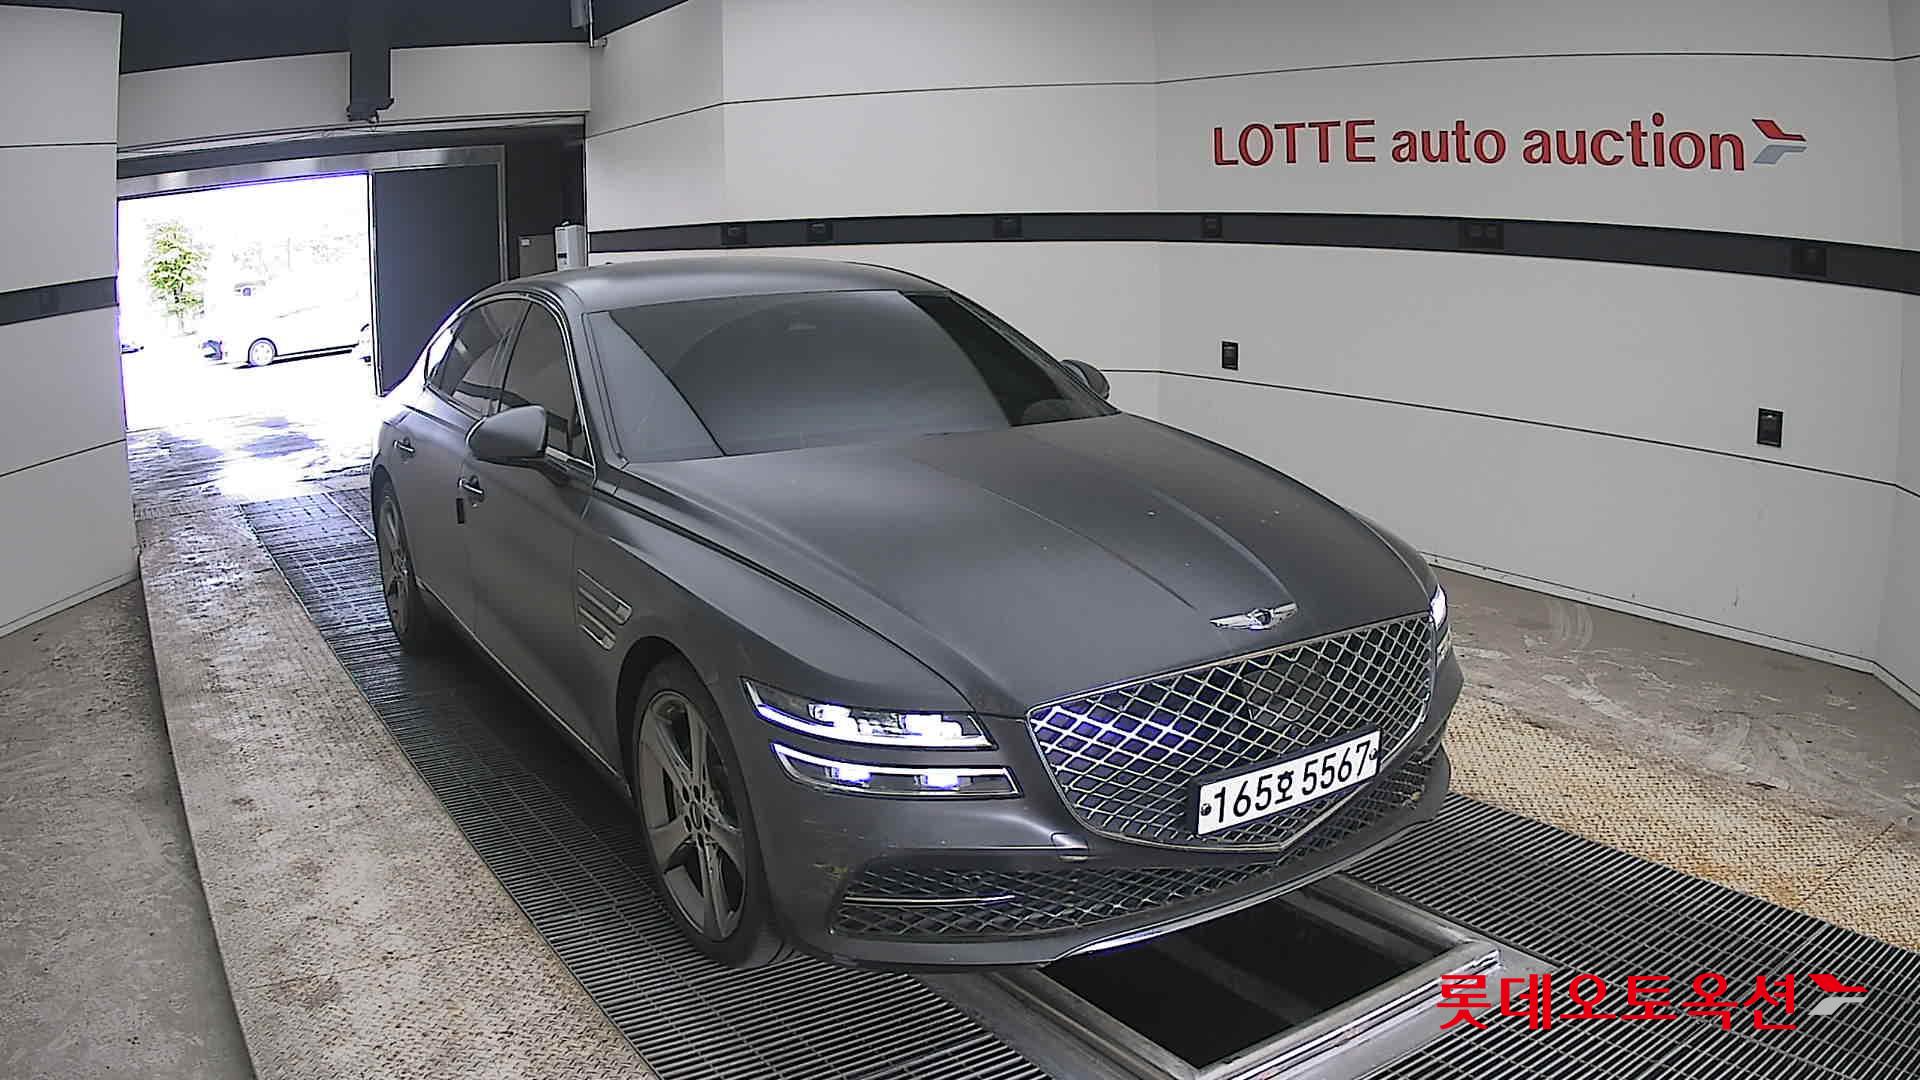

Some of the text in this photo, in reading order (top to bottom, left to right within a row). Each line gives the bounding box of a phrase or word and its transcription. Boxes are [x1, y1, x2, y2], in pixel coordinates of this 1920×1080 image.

[1213, 113, 1746, 172] LOTTE auto auction
[1213, 739, 1372, 824] 165호 5567
